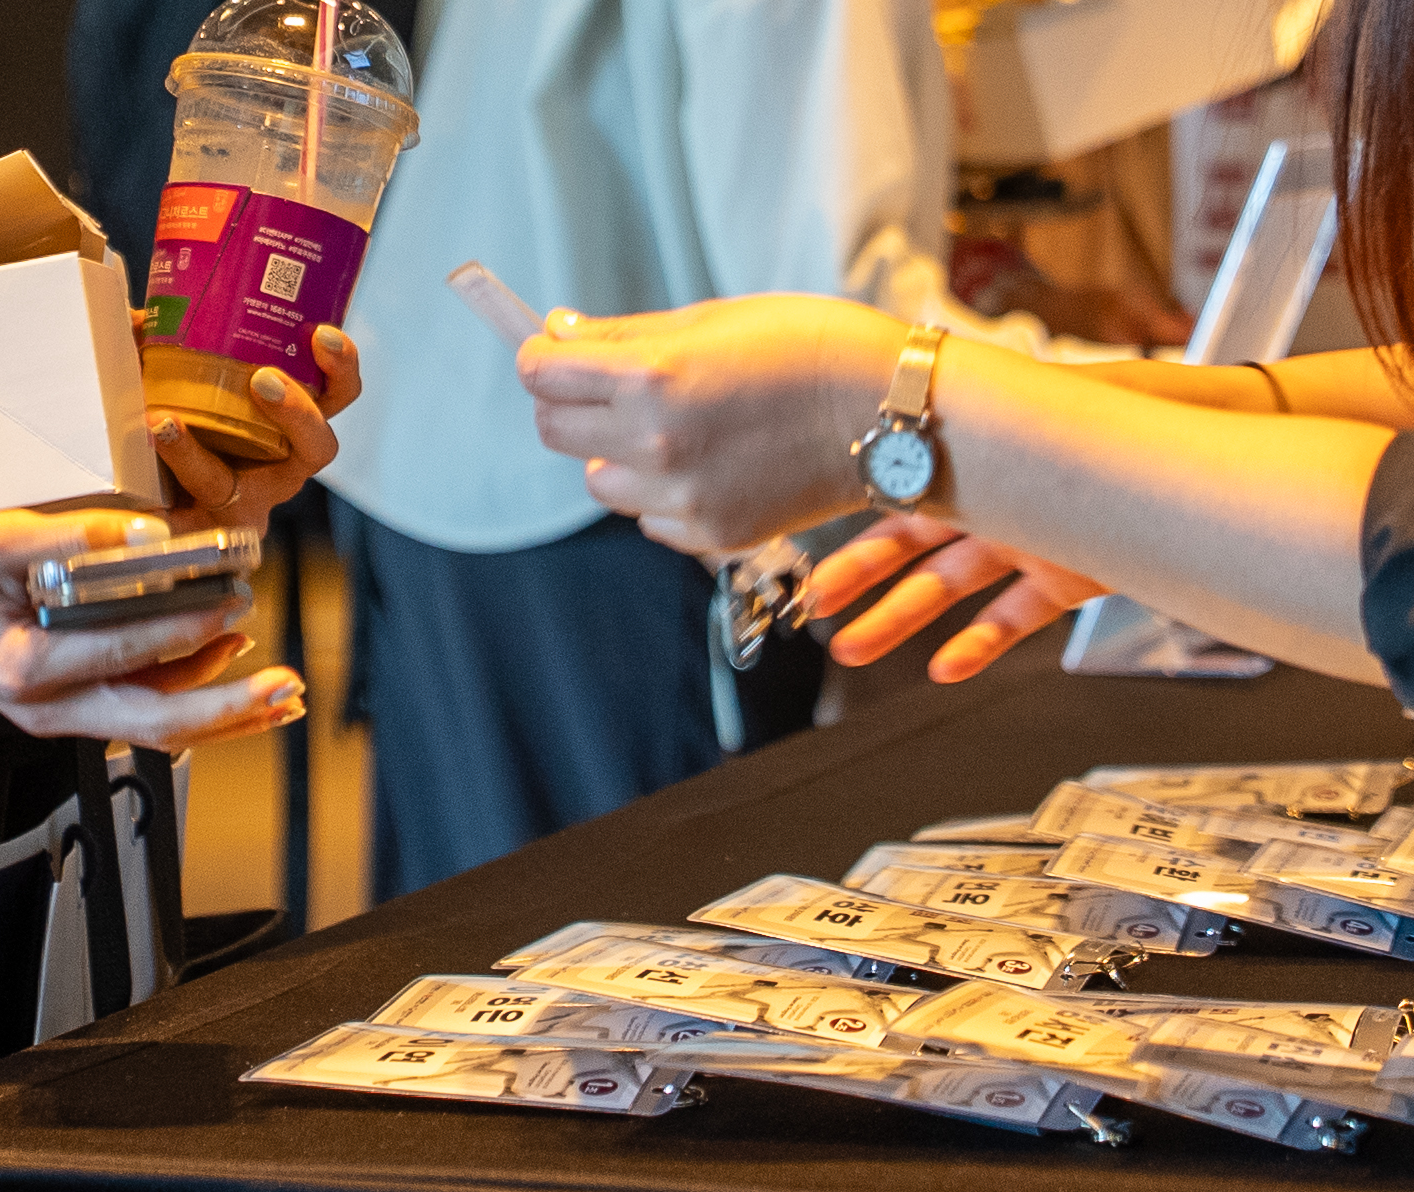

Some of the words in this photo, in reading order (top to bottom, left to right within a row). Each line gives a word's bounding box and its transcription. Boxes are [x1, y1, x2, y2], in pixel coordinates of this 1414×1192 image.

[269, 303, 304, 323] 1661-4553
[813, 897, 879, 927] 상호
[376, 1035, 459, 1063] 이연
